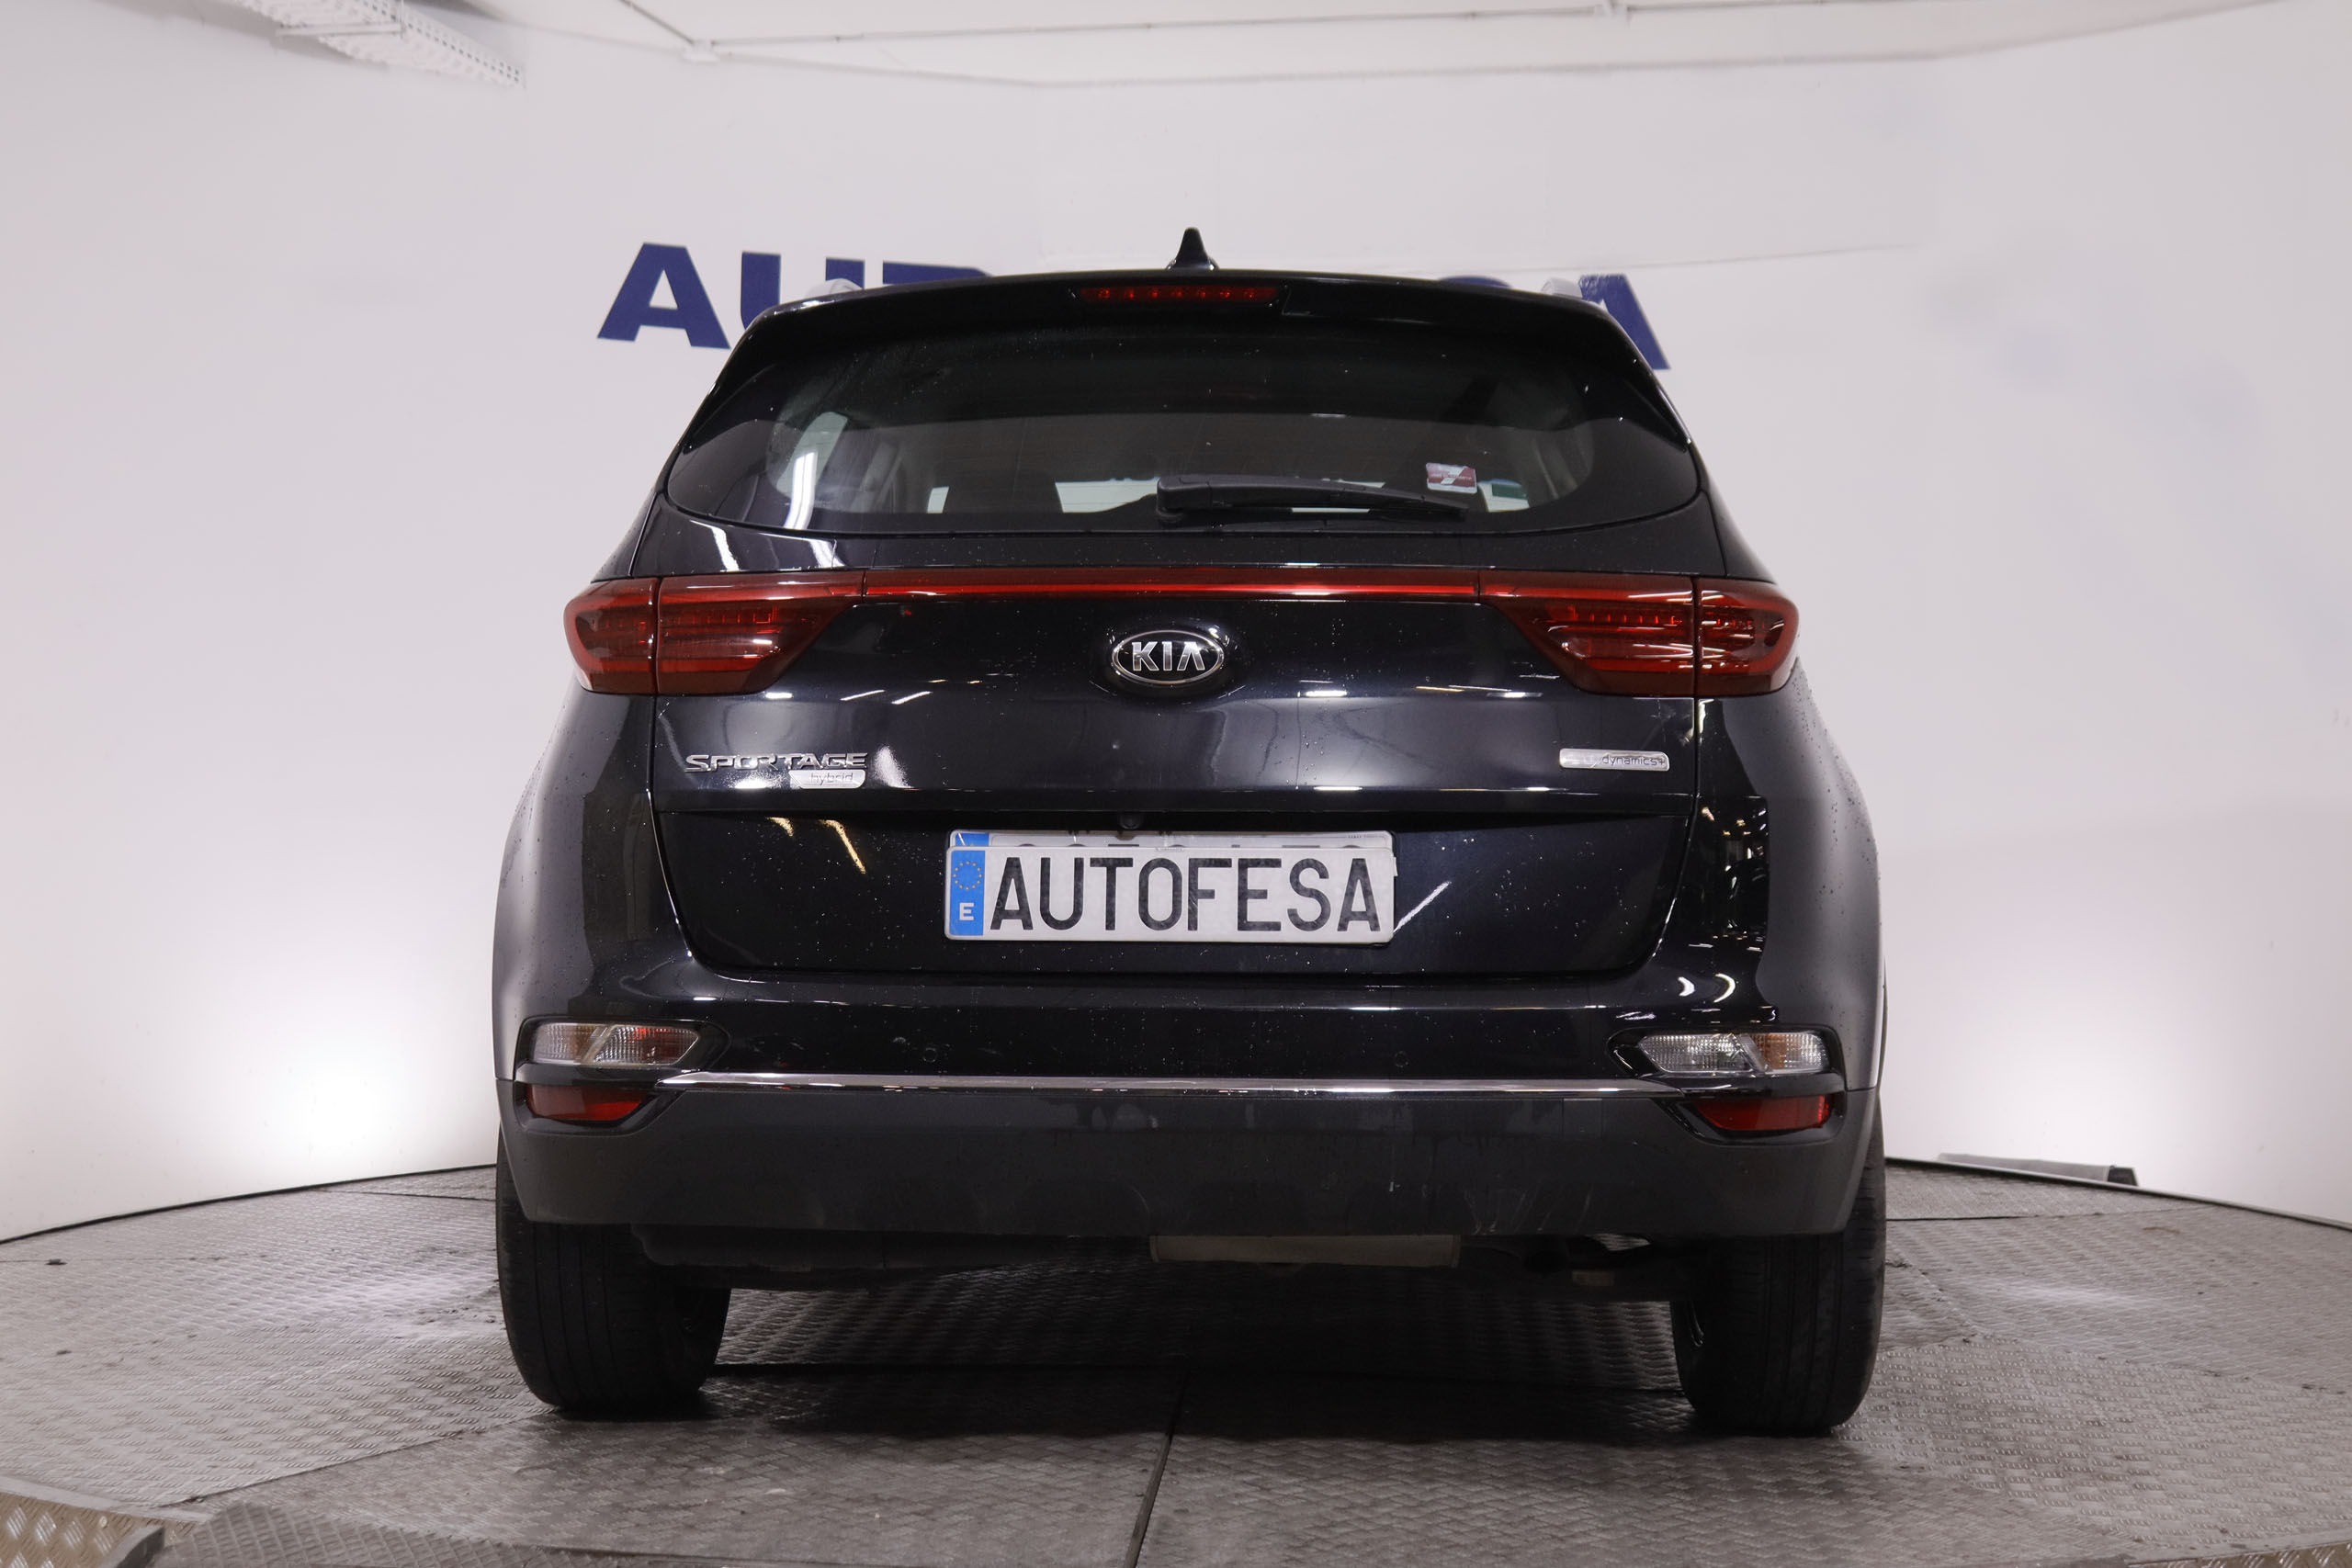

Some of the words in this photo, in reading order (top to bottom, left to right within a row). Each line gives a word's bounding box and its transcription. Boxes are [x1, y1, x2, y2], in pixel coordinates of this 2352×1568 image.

[1131, 641, 1205, 671] KIA
[684, 752, 868, 773] SPORTAGE
[810, 772, 853, 786] hybrid
[989, 856, 1382, 932] AUTOFESA
[958, 902, 975, 921] E
